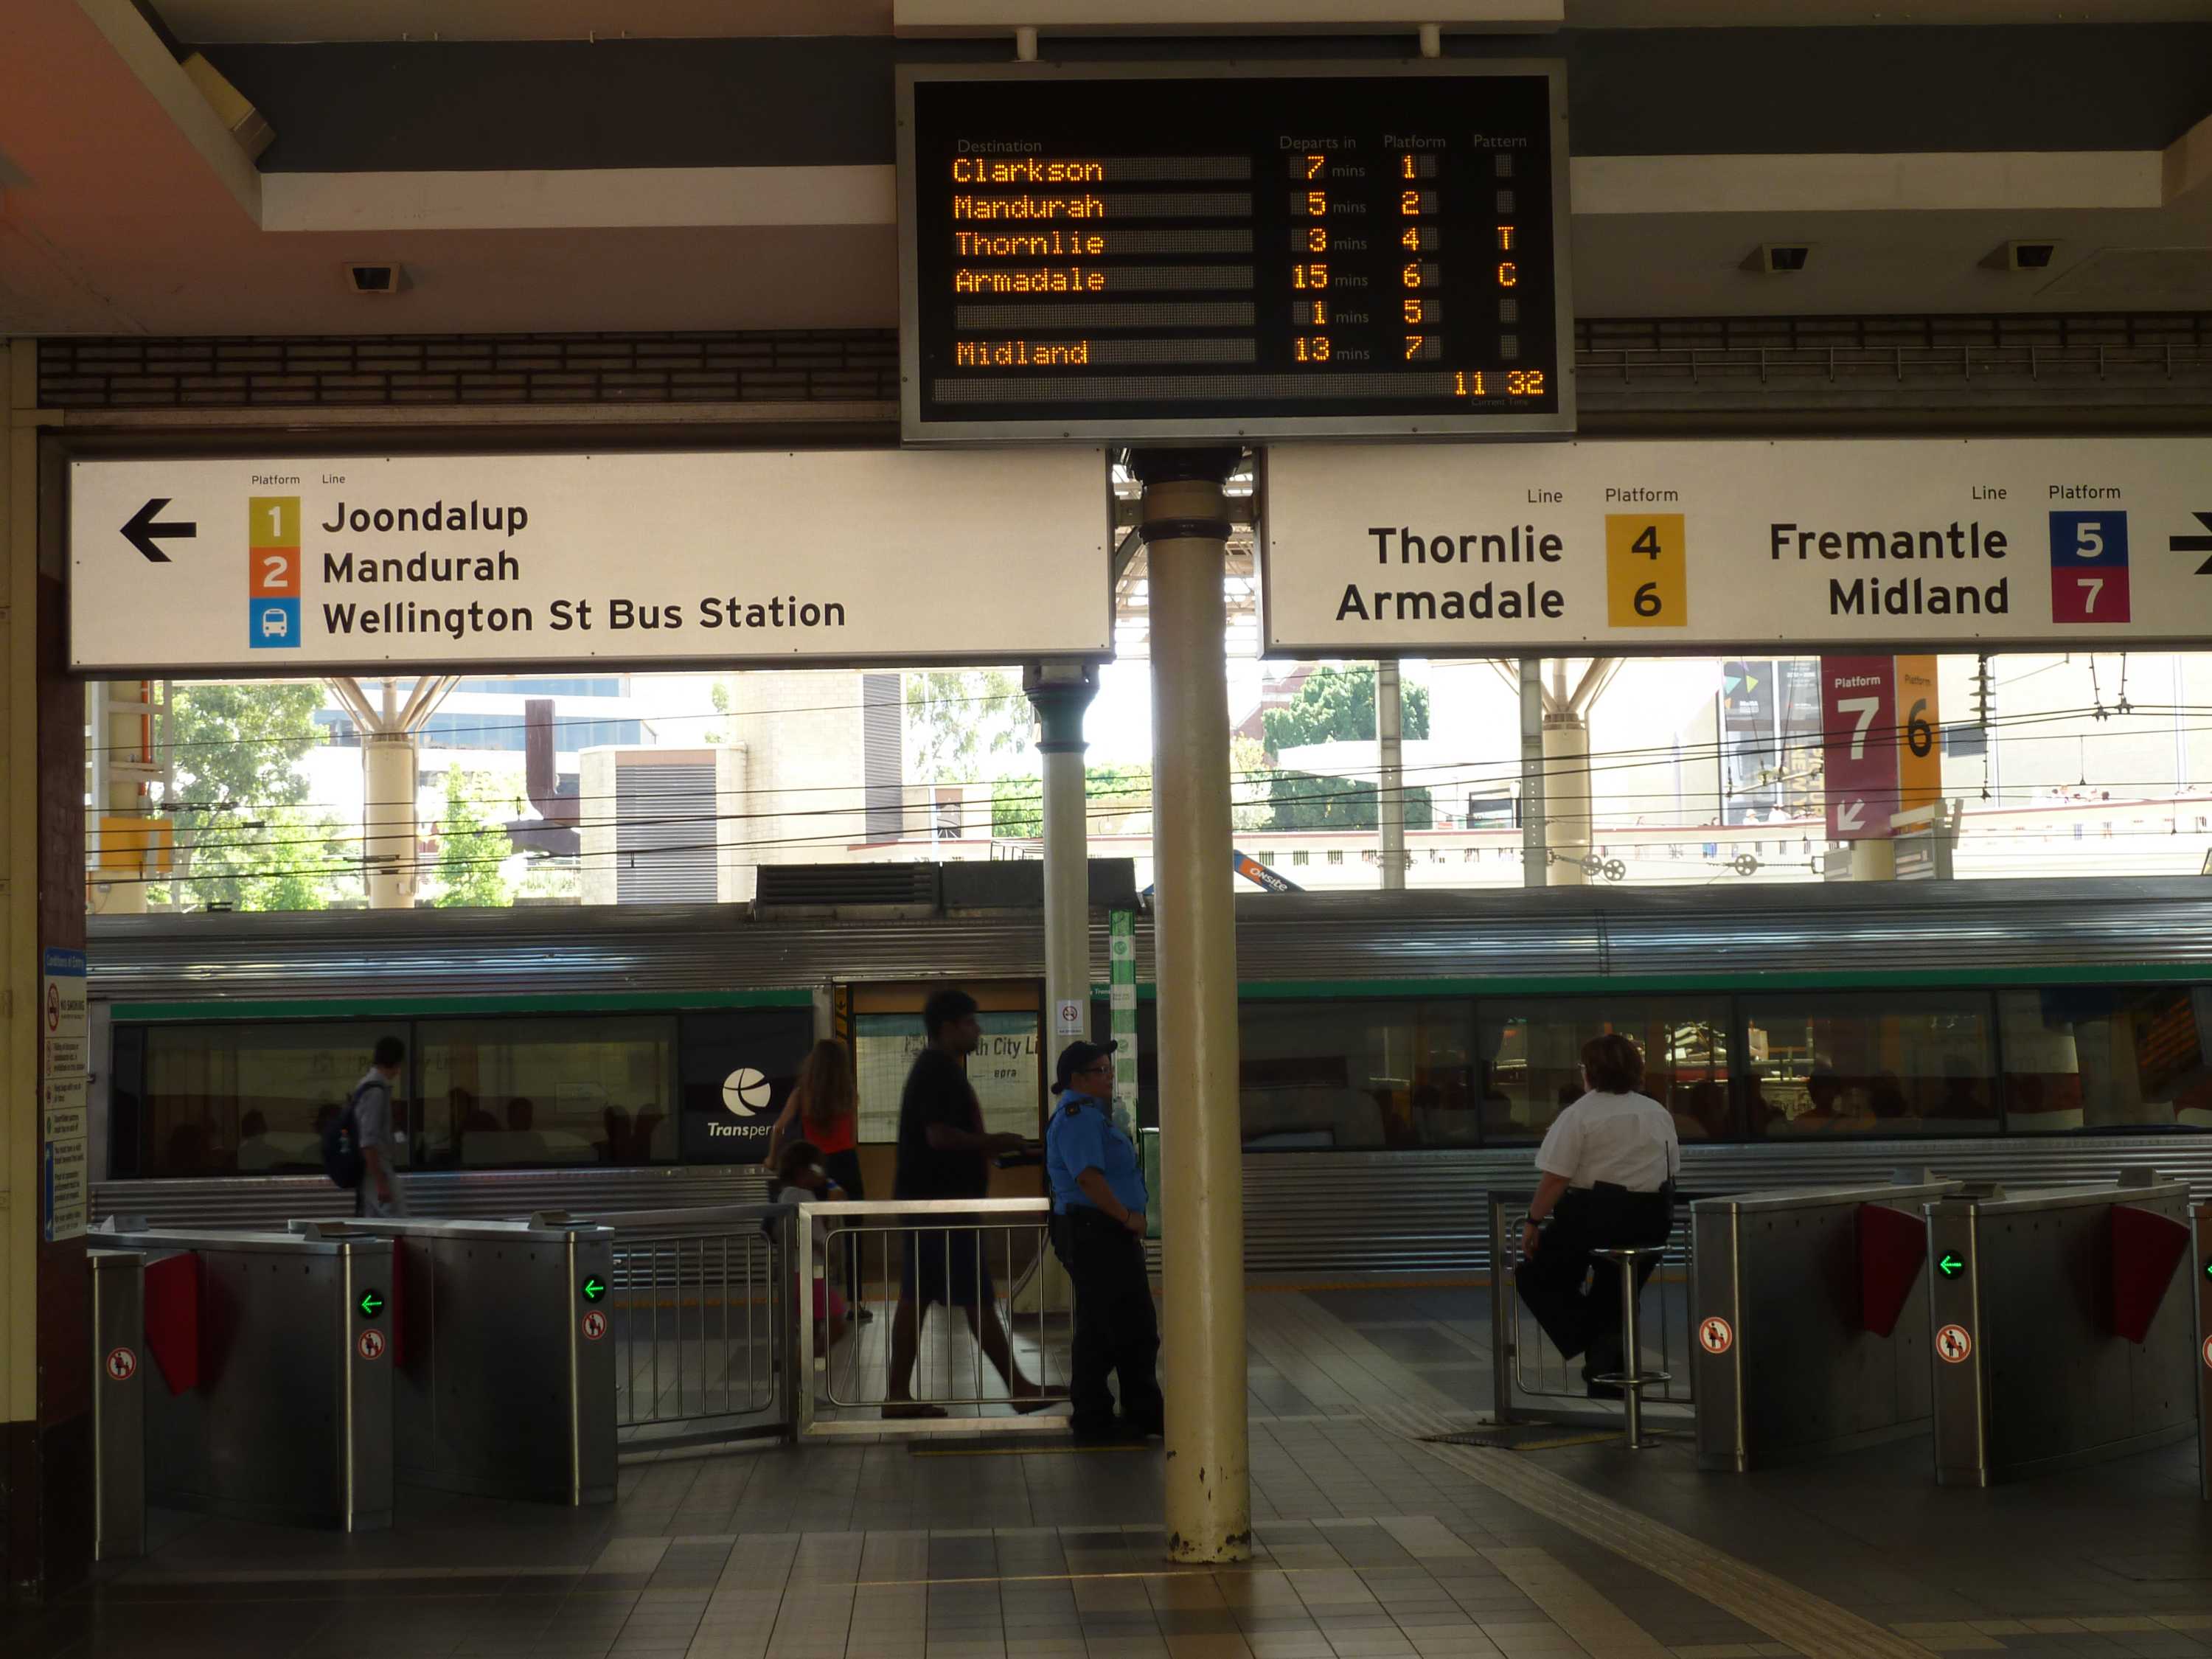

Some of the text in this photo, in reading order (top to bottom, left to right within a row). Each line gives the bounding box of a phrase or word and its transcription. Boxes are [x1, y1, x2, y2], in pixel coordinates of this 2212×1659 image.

[958, 139, 1042, 153] Destination
[1280, 136, 1357, 150] Departs in
[1385, 134, 1446, 148] Platform
[1474, 134, 1527, 147] Pattern
[954, 159, 1102, 182] Clarkson
[1308, 156, 1366, 179] 7 mins
[1404, 156, 1414, 178] 1
[955, 195, 1102, 218] Mandurah
[1309, 192, 1367, 215] 5 mins
[1402, 191, 1419, 215] 2
[956, 231, 1103, 255] Thornlie
[1310, 229, 1368, 251] 3 mins
[1402, 228, 1419, 251] 4
[1498, 226, 1514, 249] T
[956, 268, 1104, 292] Armadale
[1295, 265, 1368, 288] 15 mins
[1404, 264, 1420, 288] 6
[1498, 262, 1516, 286] C
[1314, 301, 1369, 324] 1 mins
[1405, 299, 1422, 323] 5
[958, 341, 1089, 365] Midland
[1297, 337, 1370, 361] 13 mins
[1406, 336, 1422, 359] 7
[251, 474, 300, 485] Platform
[322, 474, 346, 484] Line
[1528, 489, 1563, 504] Line
[1605, 487, 1678, 502] Platform
[1972, 485, 2007, 500] Line
[2049, 484, 2121, 499] Platform
[268, 506, 281, 538] 1
[321, 499, 528, 538] Joondalup
[1368, 524, 1563, 564] Thornlie
[1631, 526, 1661, 560] 4
[1770, 521, 2008, 560] Fremantle
[2076, 522, 2104, 557] 5
[263, 556, 288, 588] 2
[324, 549, 519, 583] Mandurah
[1335, 580, 1565, 621] Armadale
[1633, 582, 1662, 617] 6
[1829, 576, 2008, 615] Midland
[2077, 578, 2104, 613] 7
[322, 595, 845, 640] Wellington St Bus Station
[1834, 675, 1881, 689] Platform
[1838, 696, 1879, 760] 7
[1907, 698, 1932, 758] 6
[994, 1037, 1020, 1059] City
[707, 1121, 784, 1140] Transper
